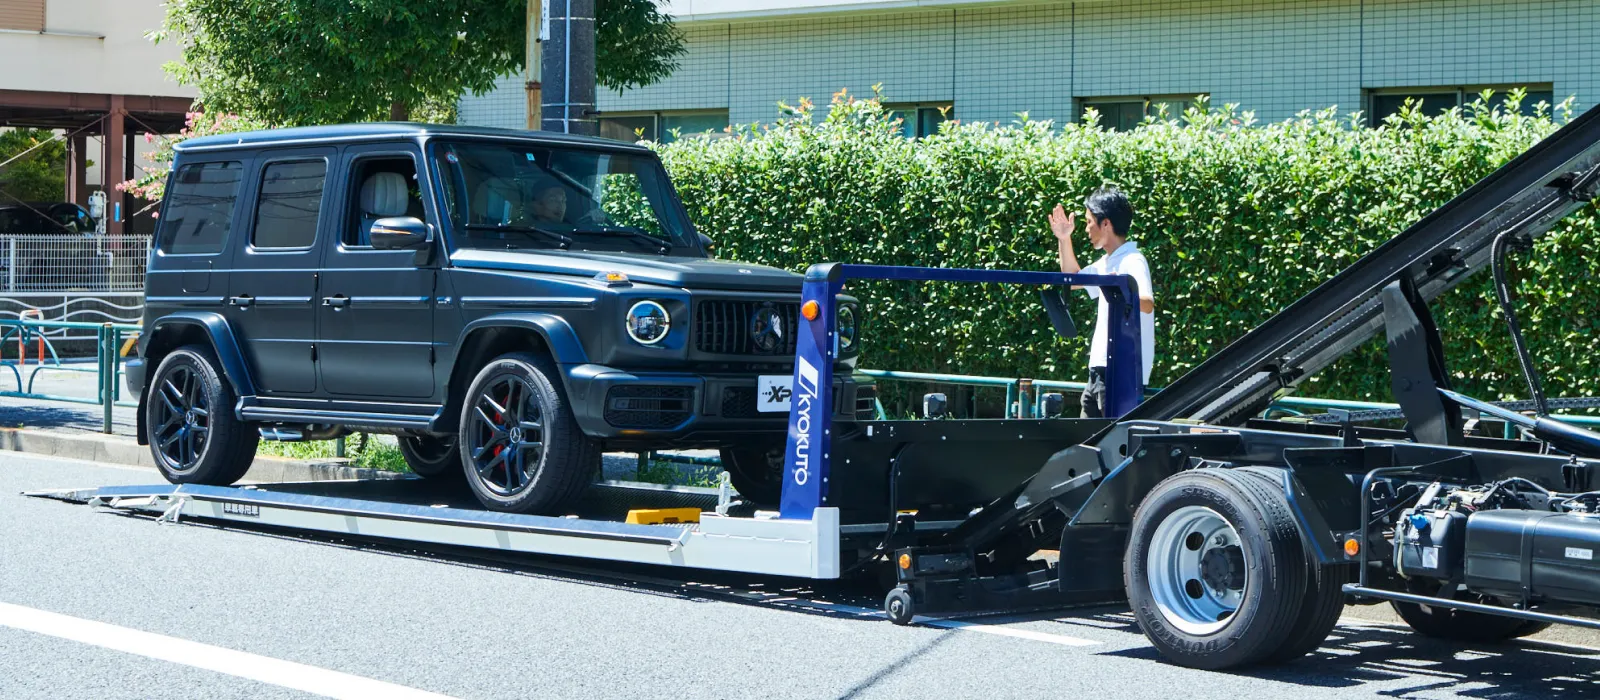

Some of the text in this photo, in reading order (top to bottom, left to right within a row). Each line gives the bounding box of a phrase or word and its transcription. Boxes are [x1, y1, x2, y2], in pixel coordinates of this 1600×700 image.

[767, 386, 793, 403] XP
[795, 393, 811, 486] KYOKUTO
[1140, 600, 1219, 655] DUNLOP
